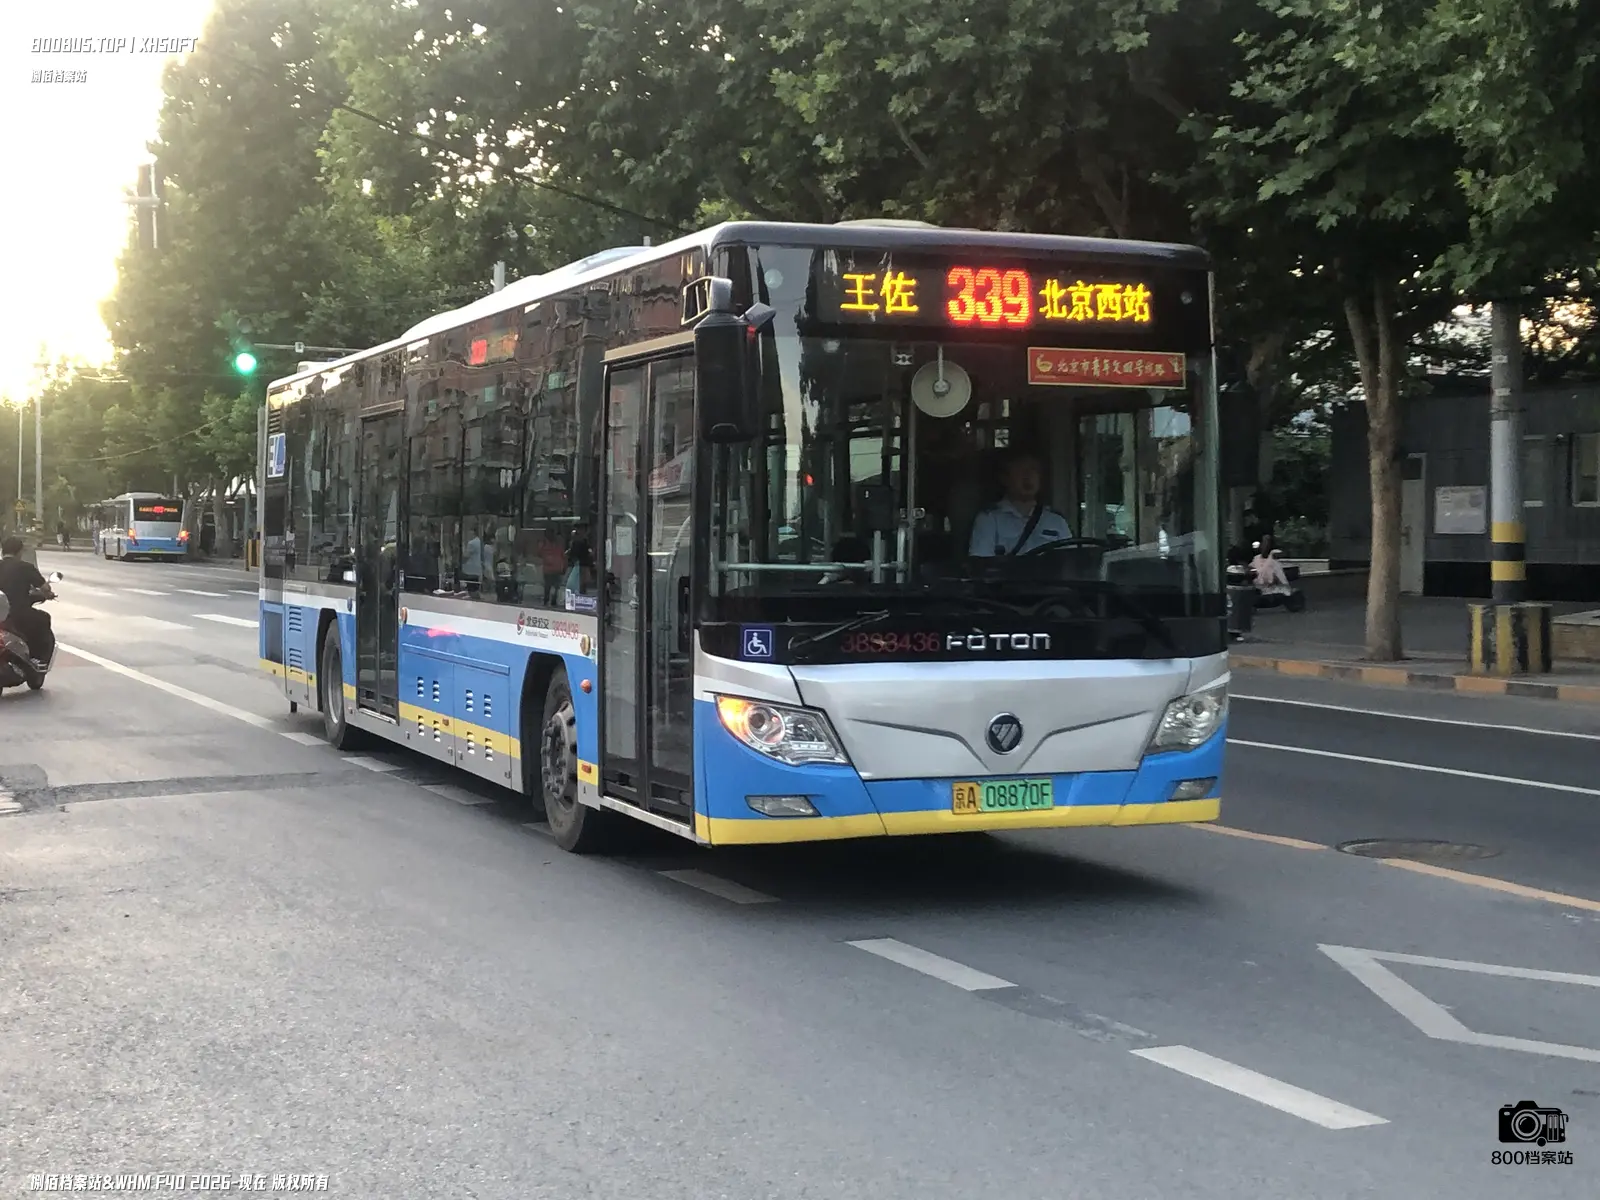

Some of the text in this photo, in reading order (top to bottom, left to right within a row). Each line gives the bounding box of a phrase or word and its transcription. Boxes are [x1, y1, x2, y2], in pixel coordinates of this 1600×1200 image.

[840, 271, 919, 313] 王佐
[948, 267, 1029, 322] 339
[1038, 279, 1150, 322] 北京西站
[945, 633, 1051, 650] FOTON
